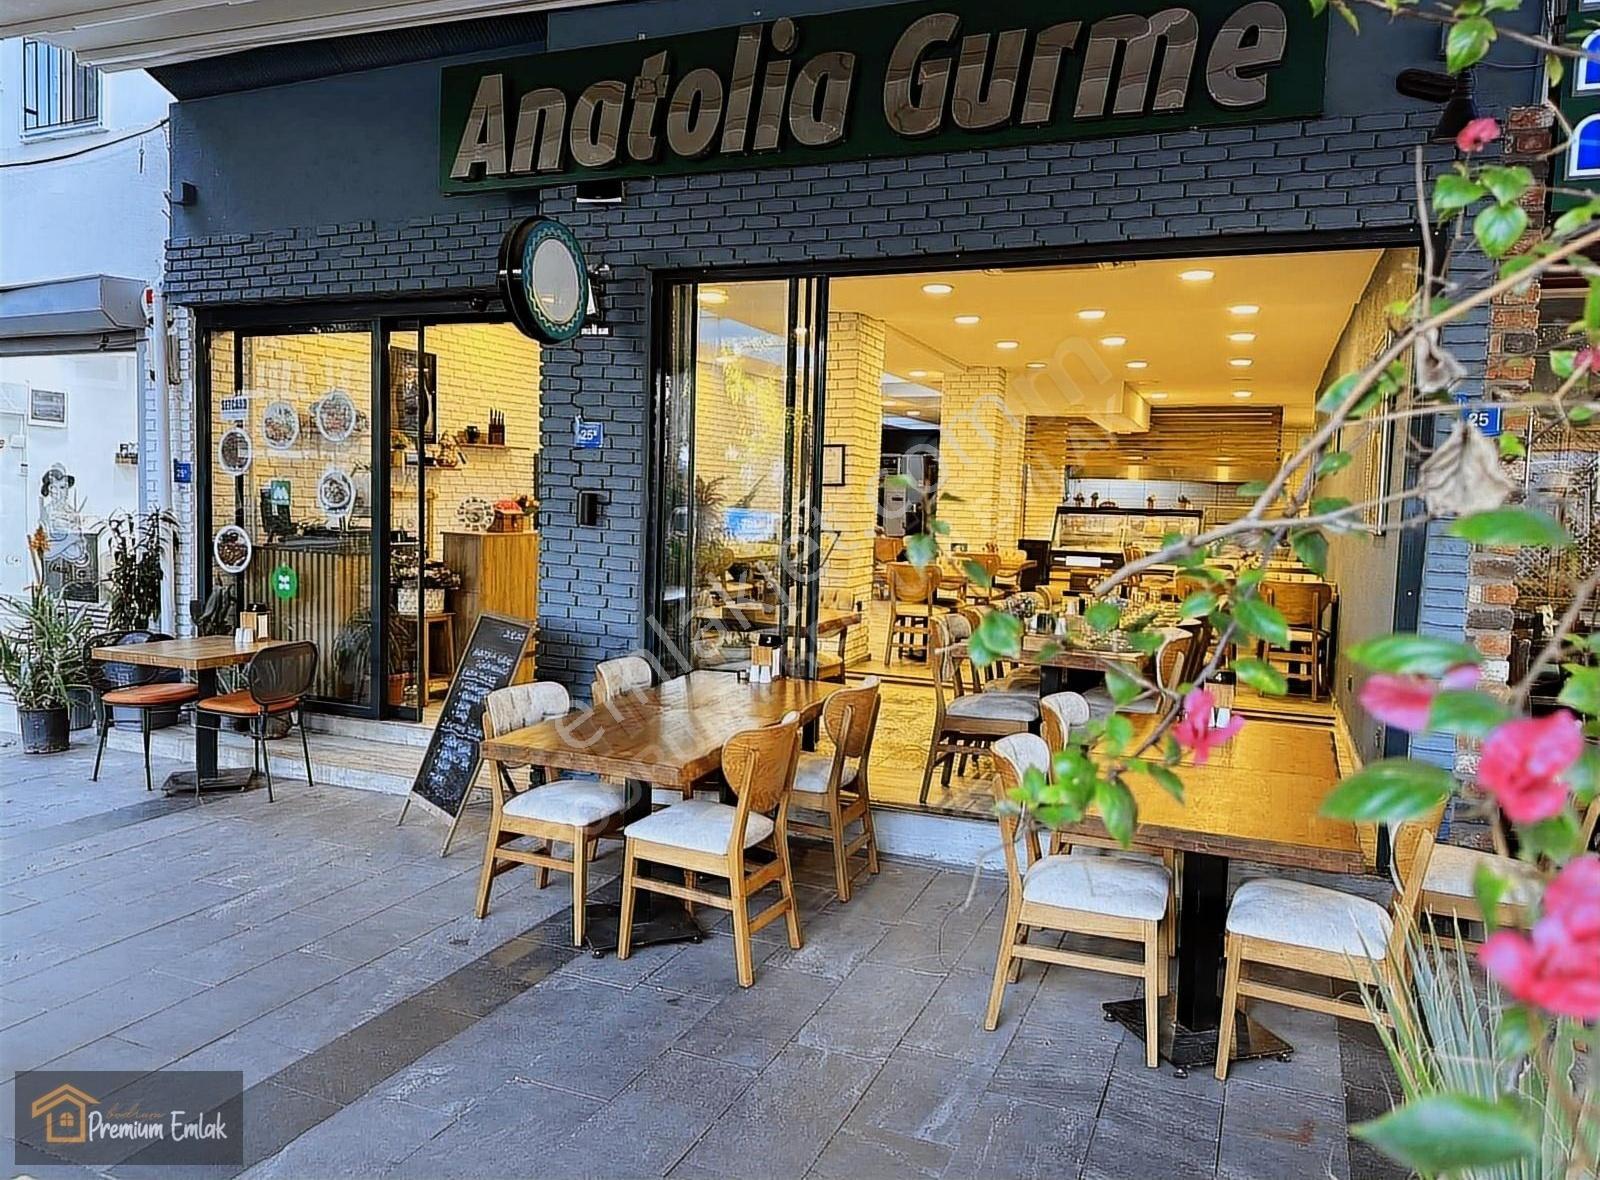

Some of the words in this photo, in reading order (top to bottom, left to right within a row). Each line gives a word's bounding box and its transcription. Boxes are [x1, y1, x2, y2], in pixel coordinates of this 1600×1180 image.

[449, 16, 858, 180] Anatolia
[883, 1, 1288, 137] Gurme
[1469, 412, 1489, 427] 25
